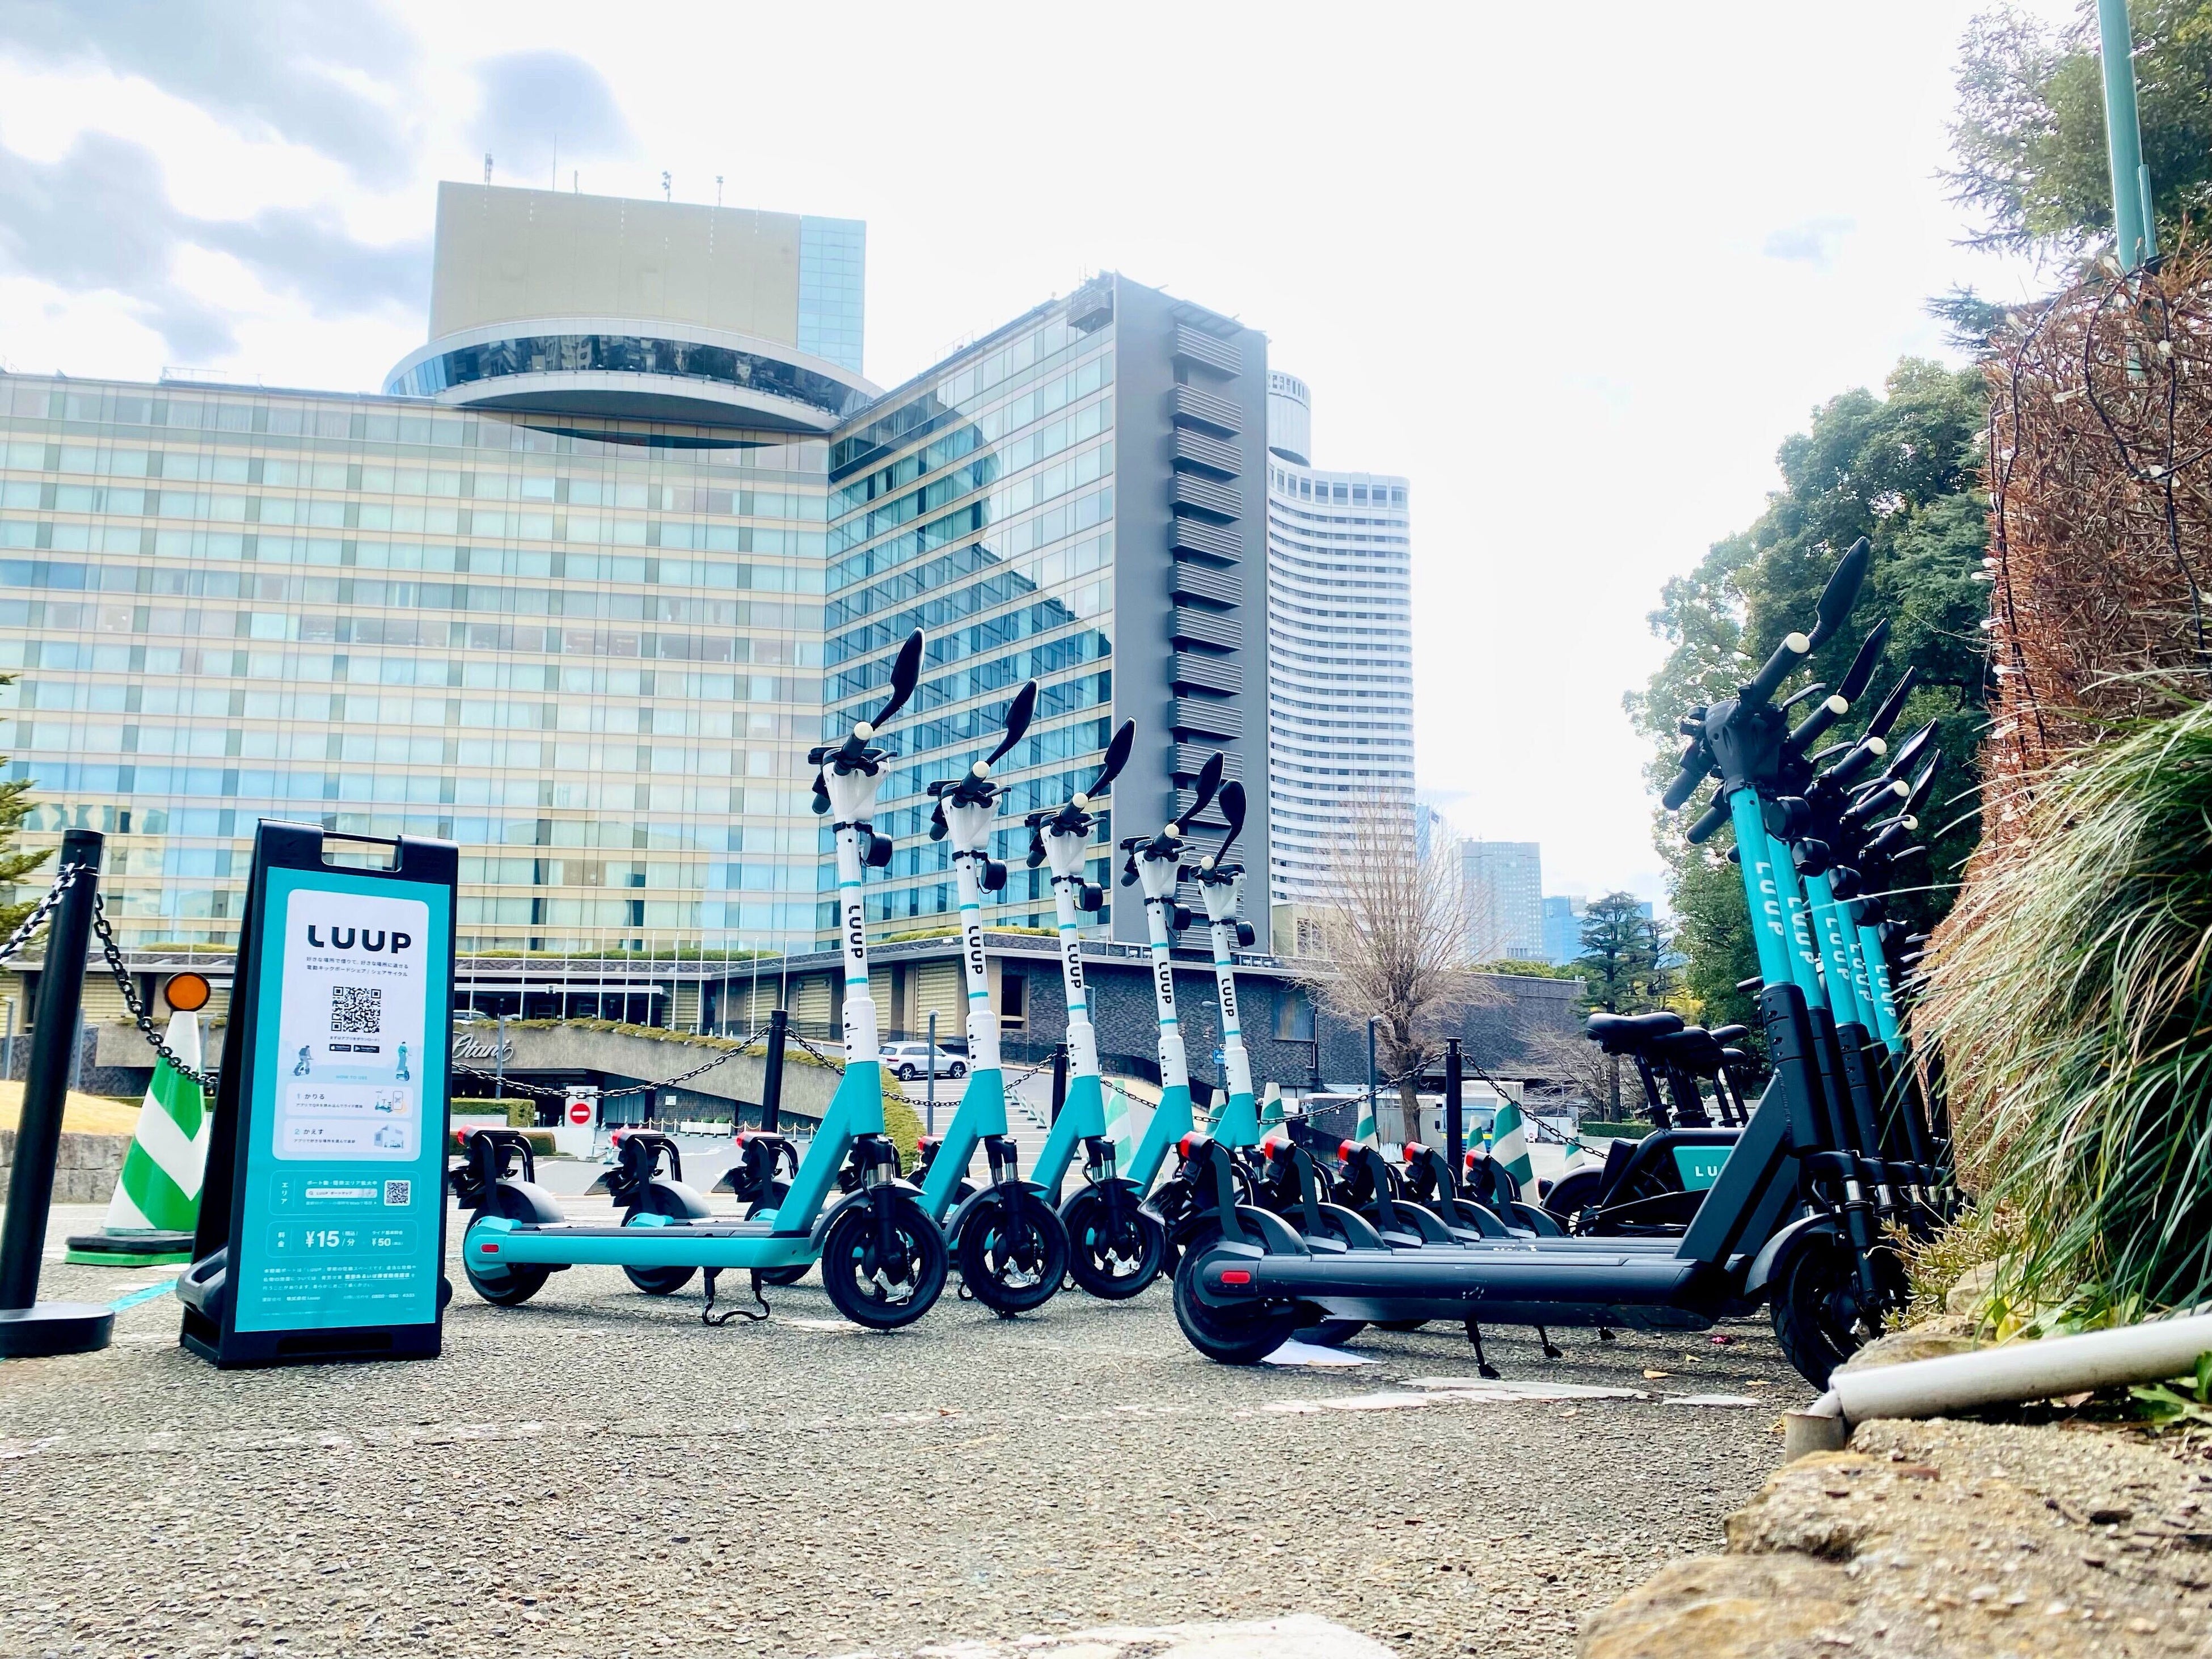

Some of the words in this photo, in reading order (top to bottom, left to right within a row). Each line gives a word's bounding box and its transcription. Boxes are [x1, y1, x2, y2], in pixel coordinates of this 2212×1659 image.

[1755, 862, 1784, 936] LUUP
[307, 925, 411, 954] LUUP
[848, 905, 863, 959] LUUP
[968, 925, 983, 975] LUUP
[1787, 897, 1815, 964] LUUP
[1825, 917, 1850, 981] LUUP
[1067, 943, 1082, 989] LUUP
[1159, 961, 1172, 1004] LUUP
[1849, 943, 1871, 1001] LUUP
[1221, 978, 1235, 1017] LUUP
[1875, 964, 1897, 1018] LUUP
[453, 1033, 513, 1062] Otani
[1695, 1166, 1718, 1177] LU
[305, 1230, 340, 1248] ¥15
